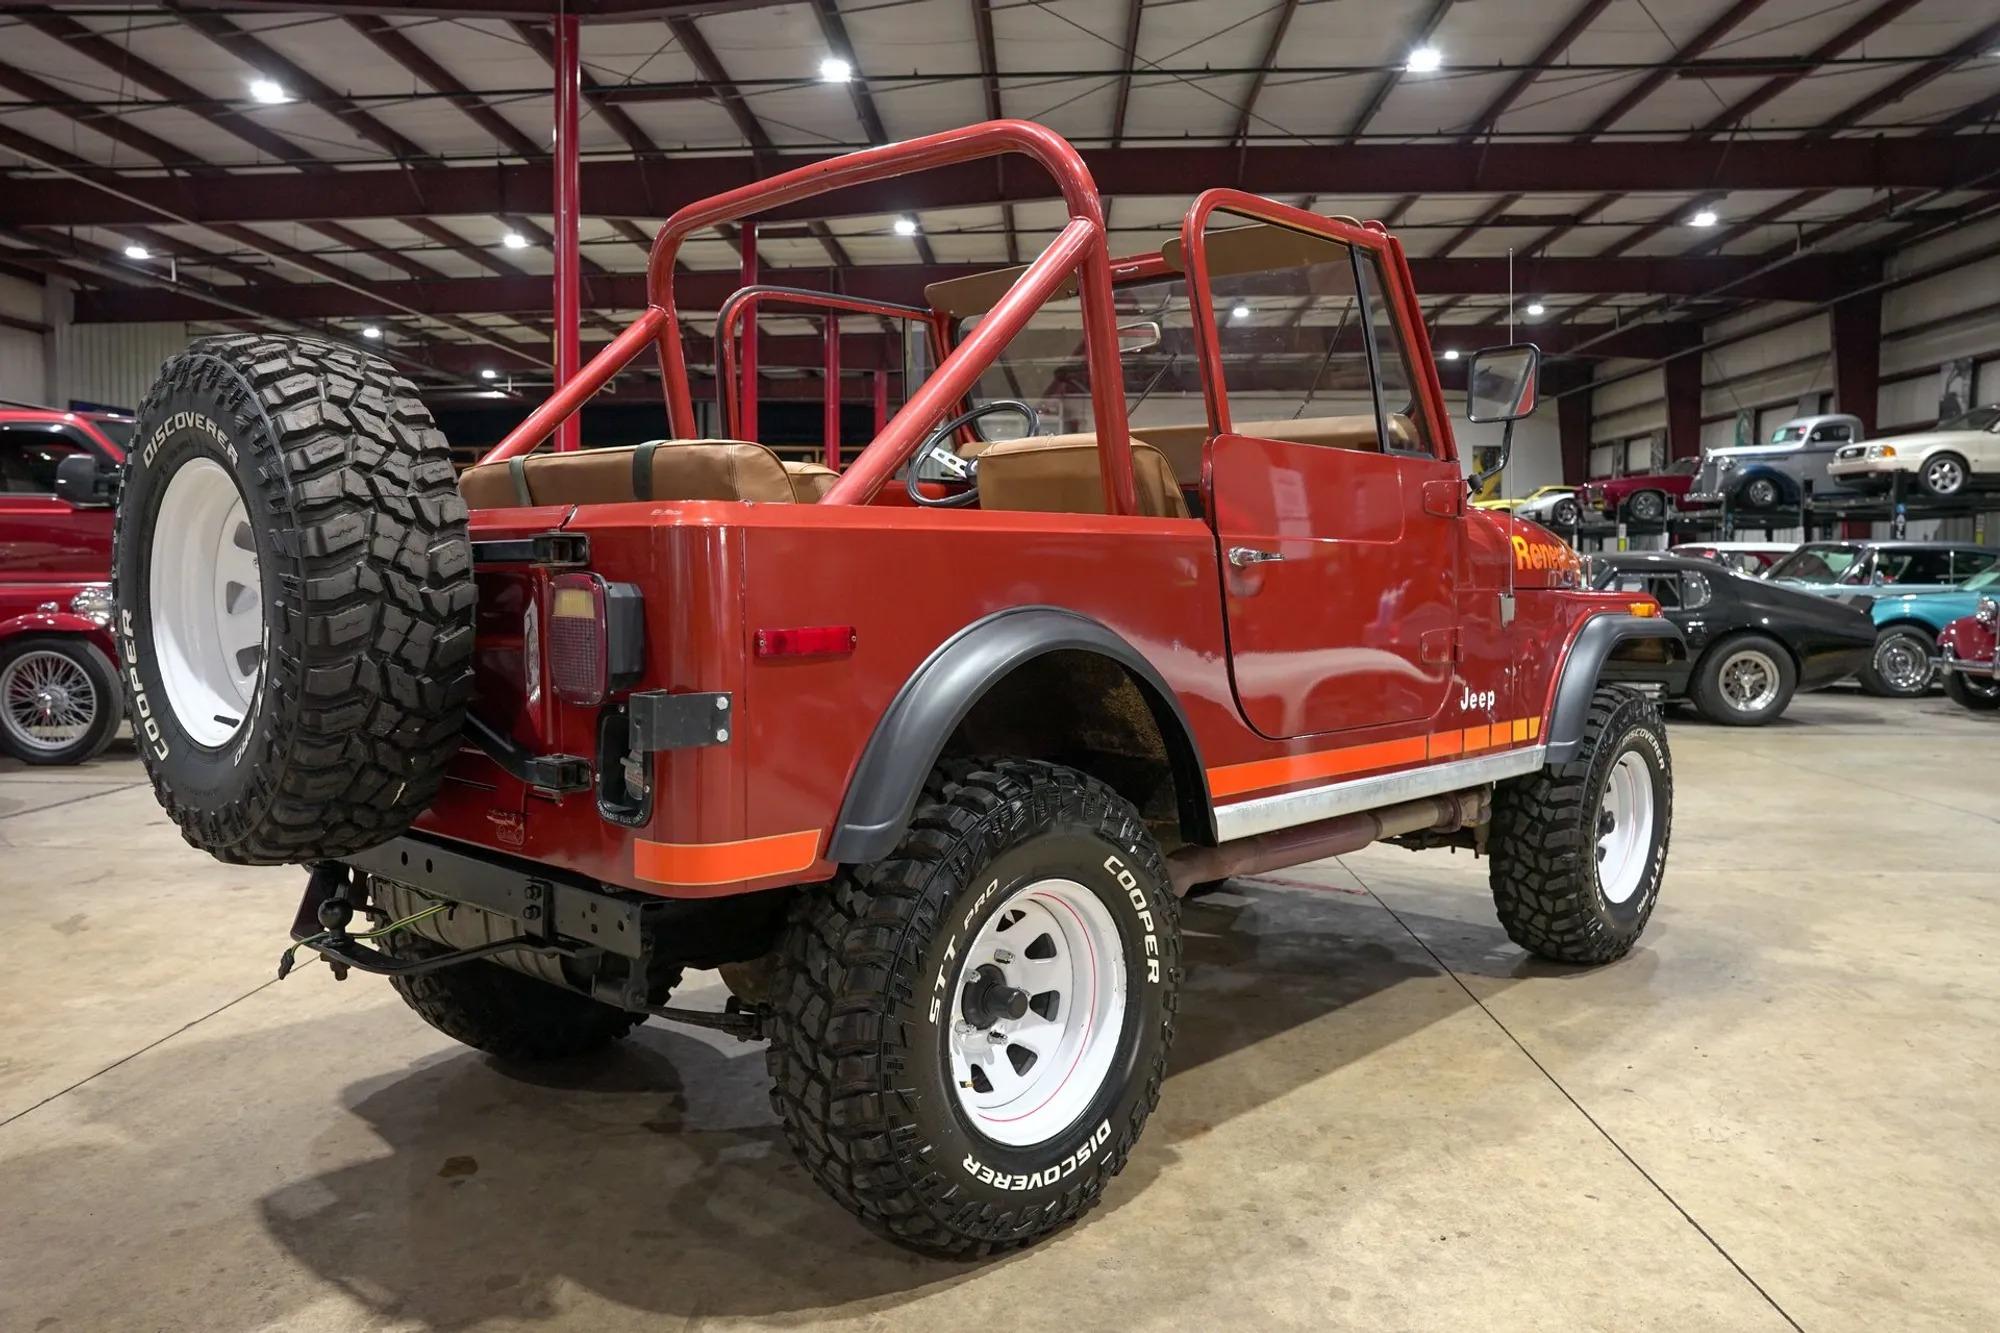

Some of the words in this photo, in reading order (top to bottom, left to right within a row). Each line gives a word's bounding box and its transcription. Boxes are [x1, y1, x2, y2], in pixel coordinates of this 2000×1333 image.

[143, 411, 239, 470] DISCOVERER
[121, 608, 170, 761] COOPER
[1460, 686, 1495, 711] Jeep
[1621, 727, 1665, 769] DISCOVERER
[928, 935, 957, 1026] STT
[963, 877, 1000, 932] PRO
[1103, 854, 1160, 984] COOPER
[961, 1117, 1113, 1192] DISCOVERER
